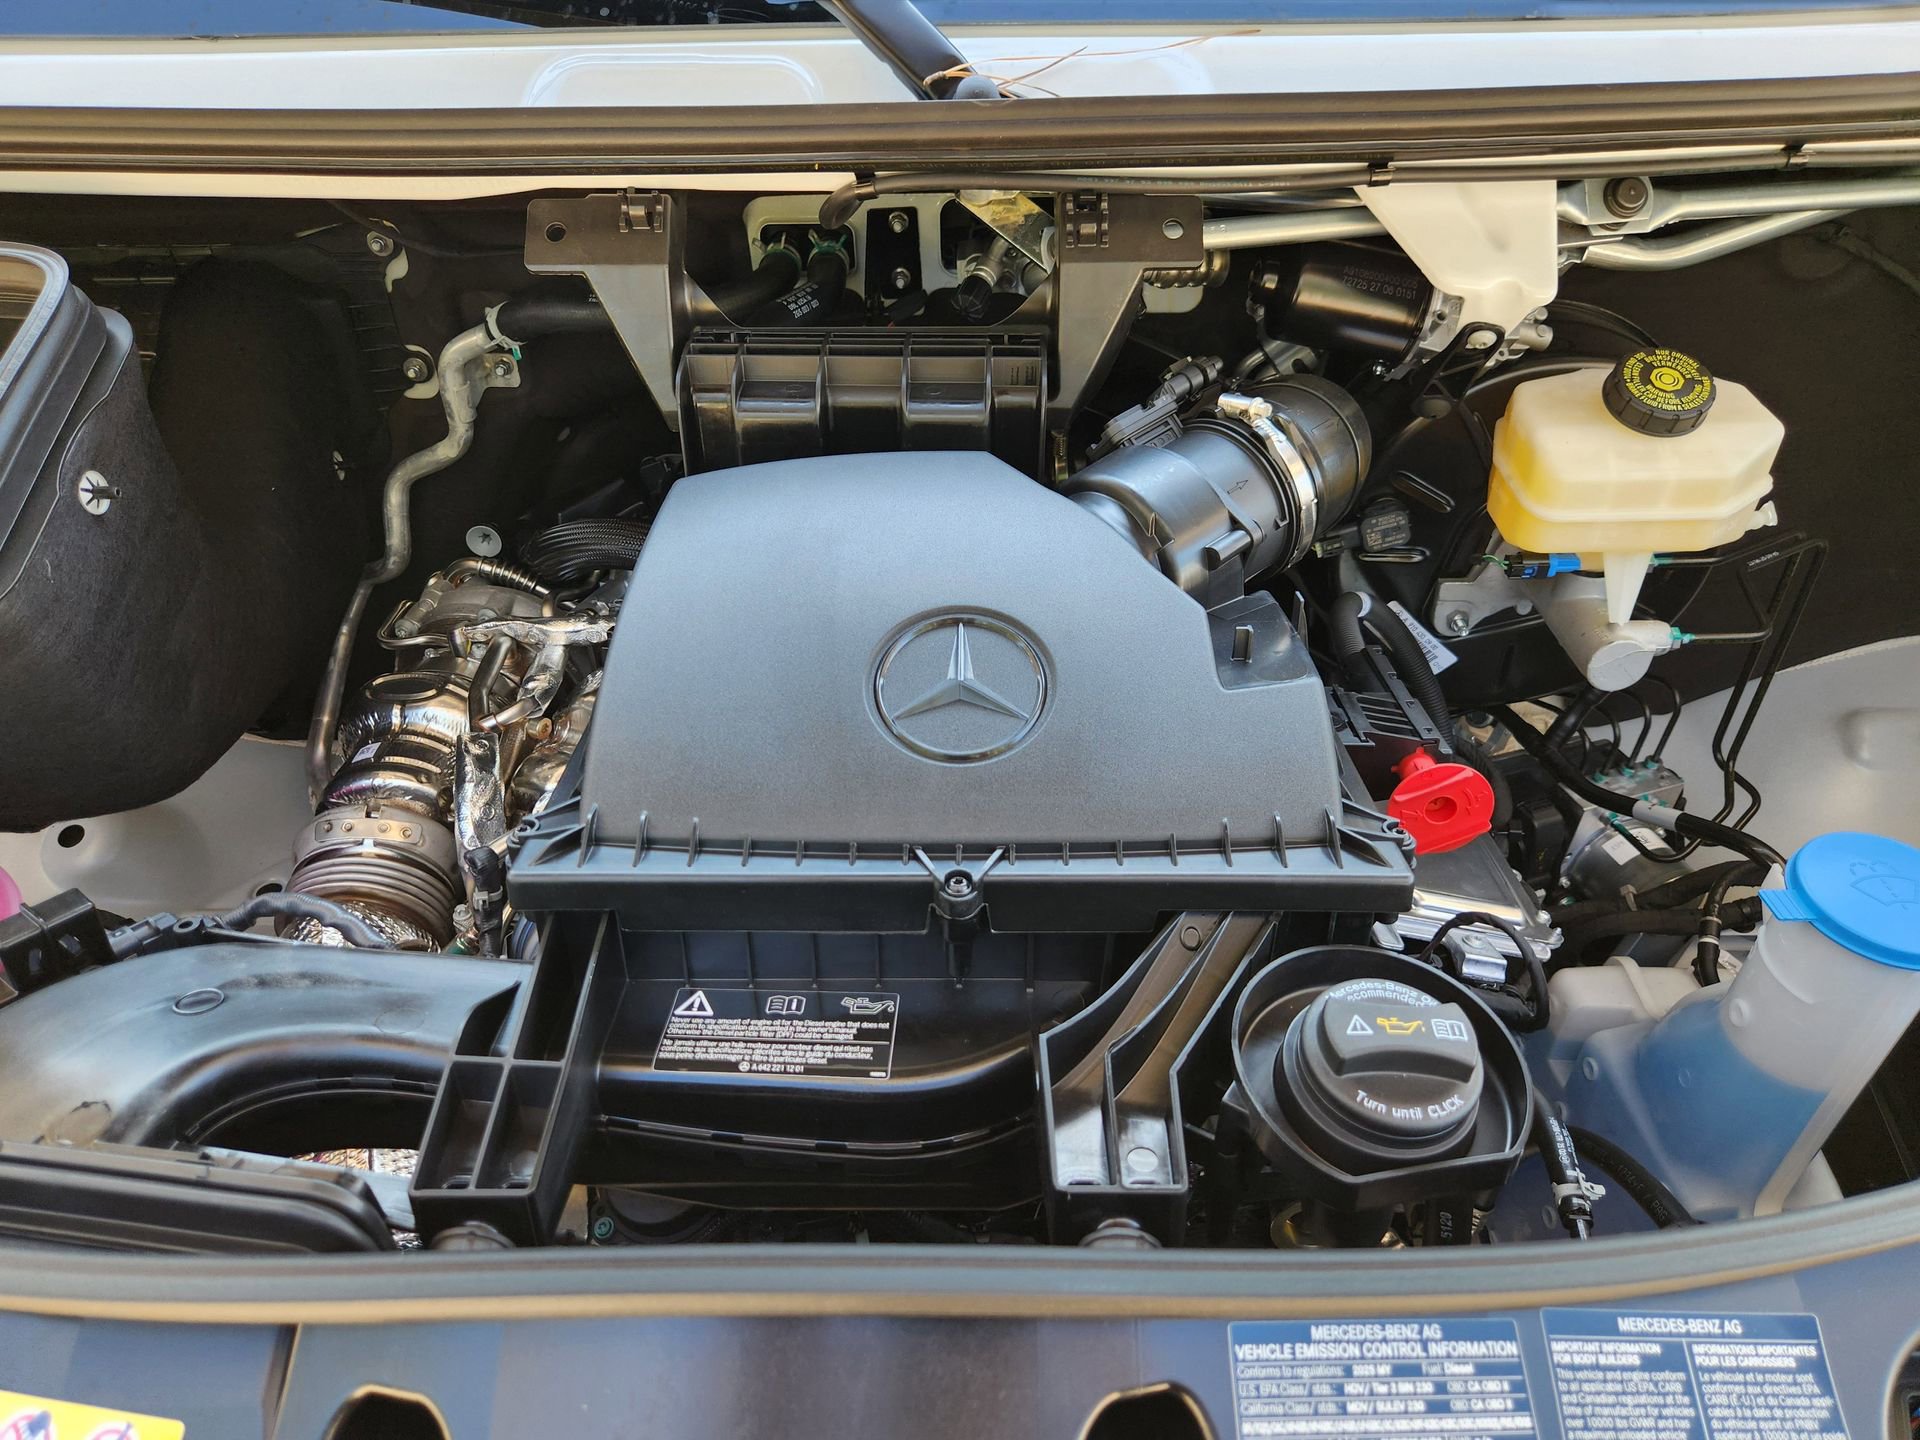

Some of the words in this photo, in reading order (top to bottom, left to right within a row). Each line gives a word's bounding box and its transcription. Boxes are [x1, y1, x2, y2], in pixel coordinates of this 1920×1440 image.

[1356, 1090, 1386, 1114] Turn
[1392, 1107, 1424, 1120] until
[1427, 1094, 1464, 1118] CLICK
[1310, 1324, 1420, 1340] MERCEDES-BENZ
[1422, 1324, 1442, 1340] AG
[1617, 1317, 1722, 1333] MERCEDES-BENZ
[1723, 1319, 1742, 1334] AG
[1235, 1343, 1294, 1360] VEHICLE
[1295, 1342, 1360, 1360] EMISSION
[1362, 1341, 1427, 1359] CONTROL
[1428, 1340, 1519, 1358] INFORMATION
[1551, 1341, 1600, 1353] IMPORTANT
[1601, 1342, 1662, 1354] INFORMATION
[1553, 1353, 1572, 1364] FOR
[1572, 1354, 1598, 1365] BODY
[1694, 1355, 1720, 1366] POUR
[1721, 1356, 1738, 1367] LES
